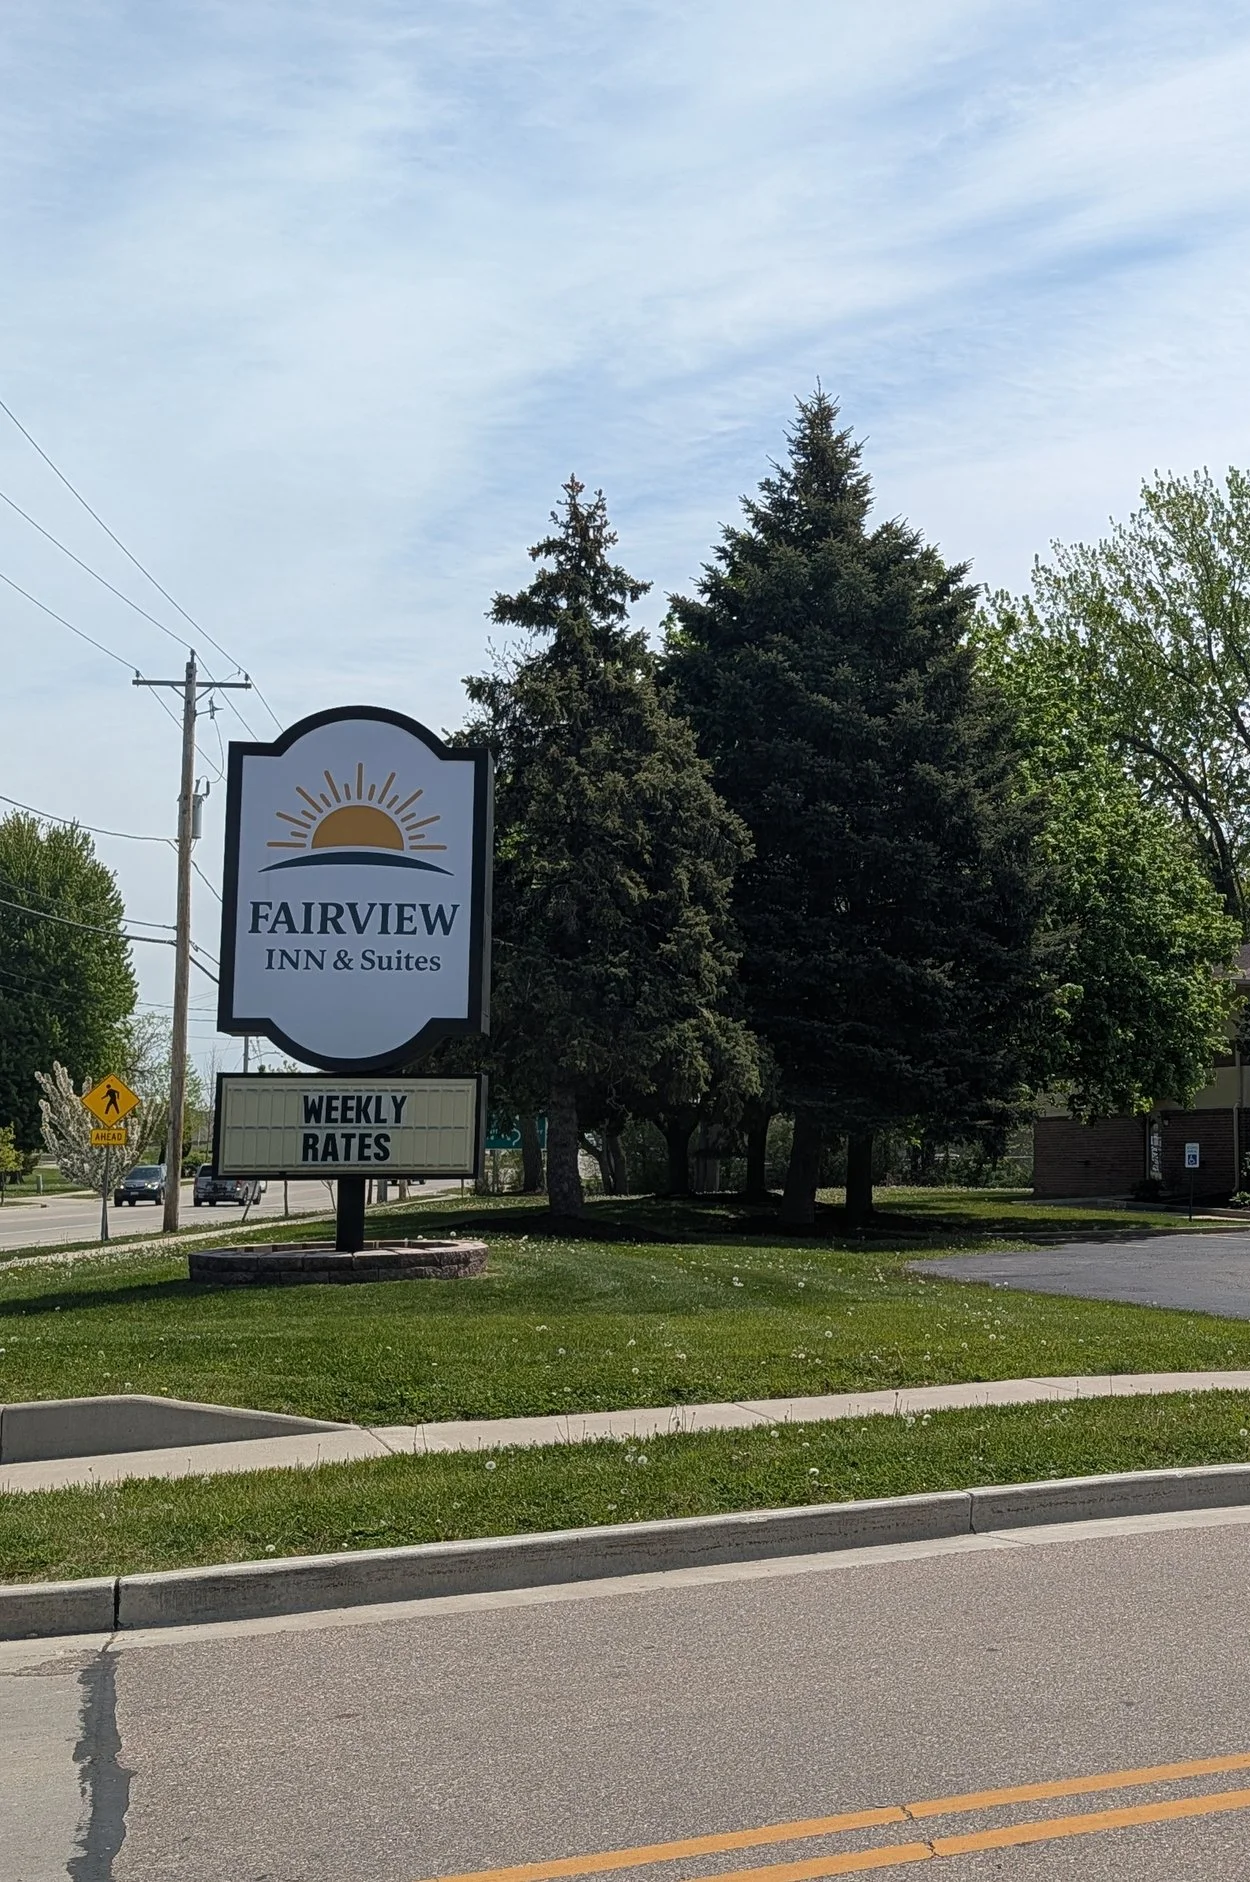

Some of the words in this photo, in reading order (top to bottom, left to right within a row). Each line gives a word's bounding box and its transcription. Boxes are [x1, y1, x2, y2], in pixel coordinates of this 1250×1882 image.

[248, 901, 460, 936] FAIRVIEW
[265, 948, 327, 970] INN
[332, 948, 354, 971] &
[360, 948, 441, 972] Suites
[303, 1095, 408, 1124] WEEKLY
[94, 1132, 123, 1141] AHEAD
[302, 1133, 391, 1162] RATES
